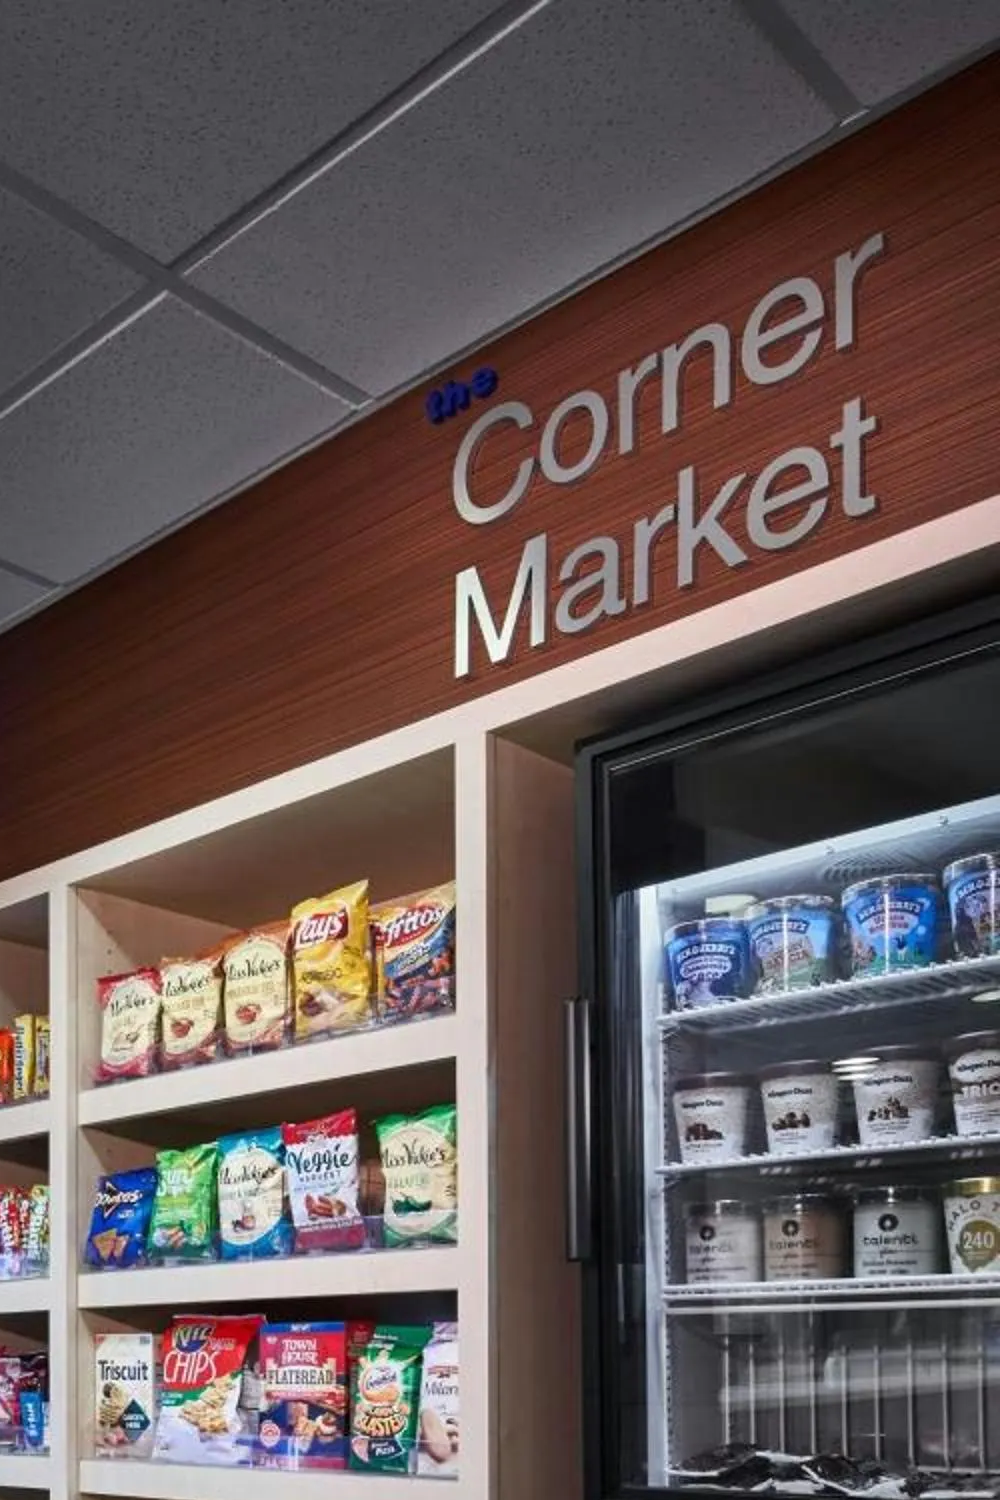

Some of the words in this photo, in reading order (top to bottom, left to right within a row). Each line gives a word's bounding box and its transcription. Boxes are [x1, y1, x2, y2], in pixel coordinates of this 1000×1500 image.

[425, 366, 498, 424] the
[453, 232, 885, 525] Corner
[454, 396, 878, 679] Market
[287, 1143, 353, 1175] Veggie
[963, 1230, 995, 1250] 240
[98, 1359, 149, 1382] Triscuit
[163, 1351, 221, 1384] CHIPS
